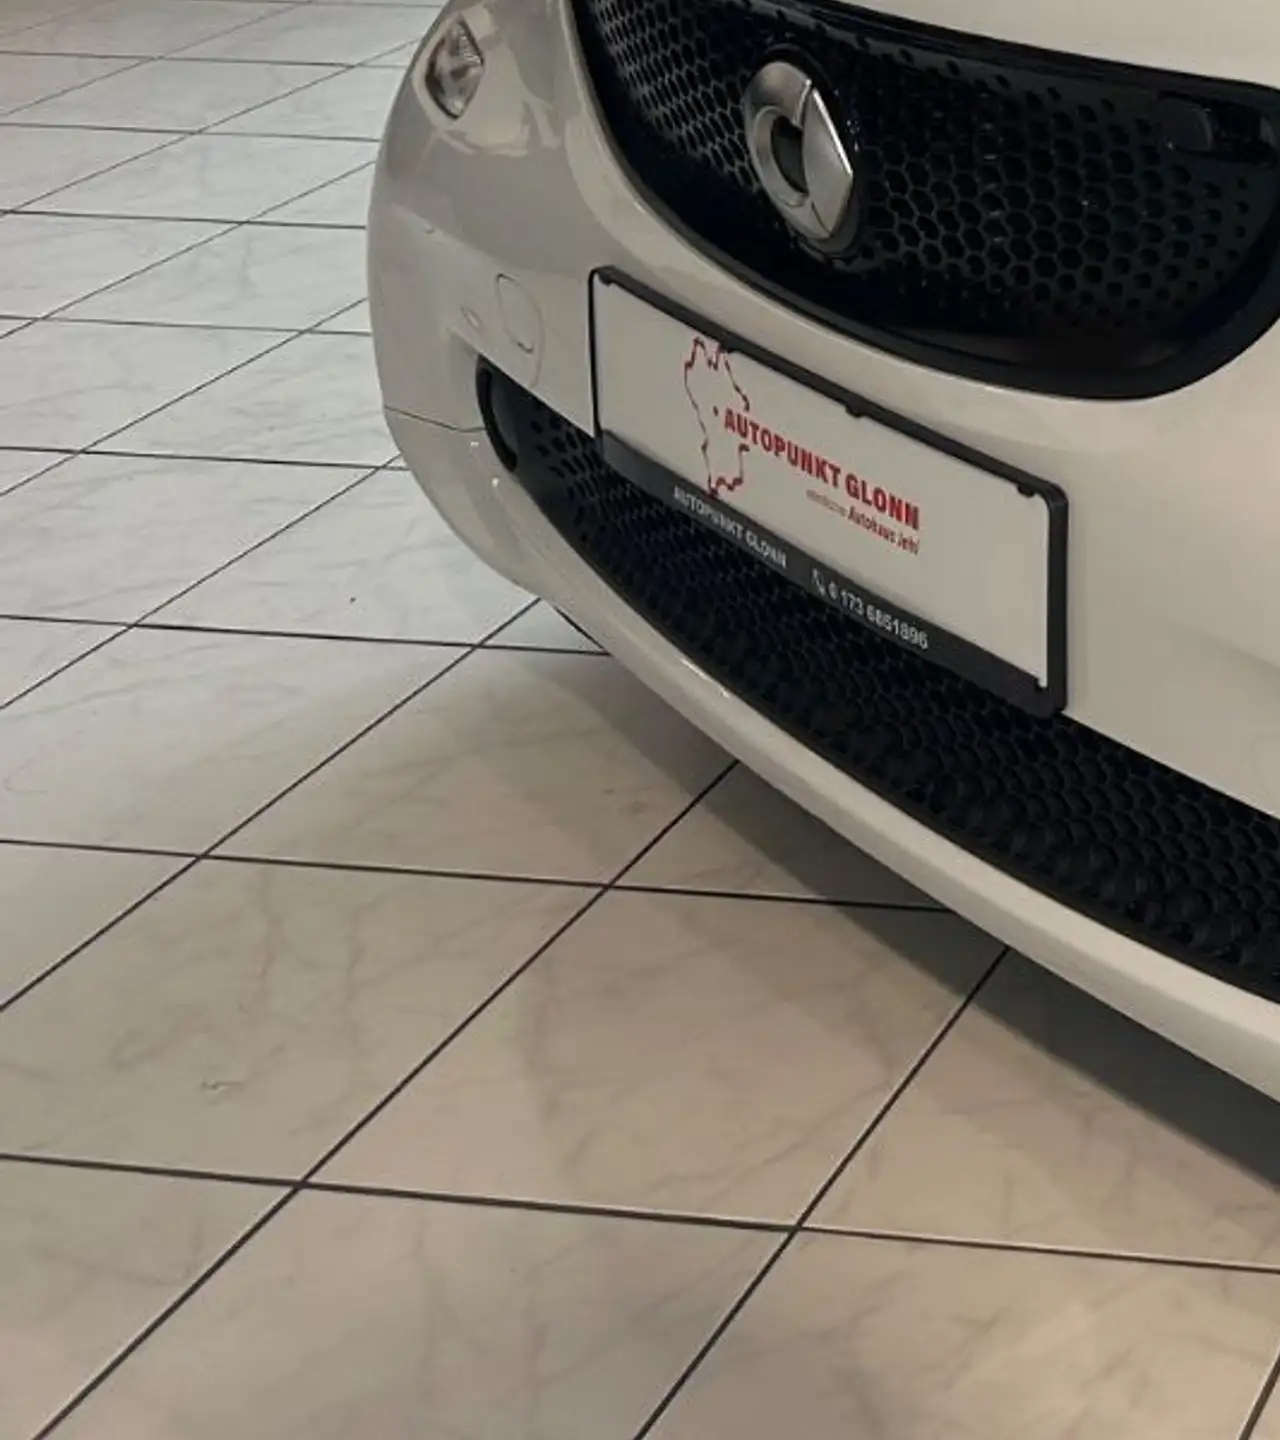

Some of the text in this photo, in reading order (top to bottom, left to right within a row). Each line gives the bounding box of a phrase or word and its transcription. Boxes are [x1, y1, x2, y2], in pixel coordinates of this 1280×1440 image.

[724, 408, 841, 489] AUTOPUNKT
[845, 473, 920, 531] GLONN
[674, 485, 787, 568] AUTOPUNKT GLONN
